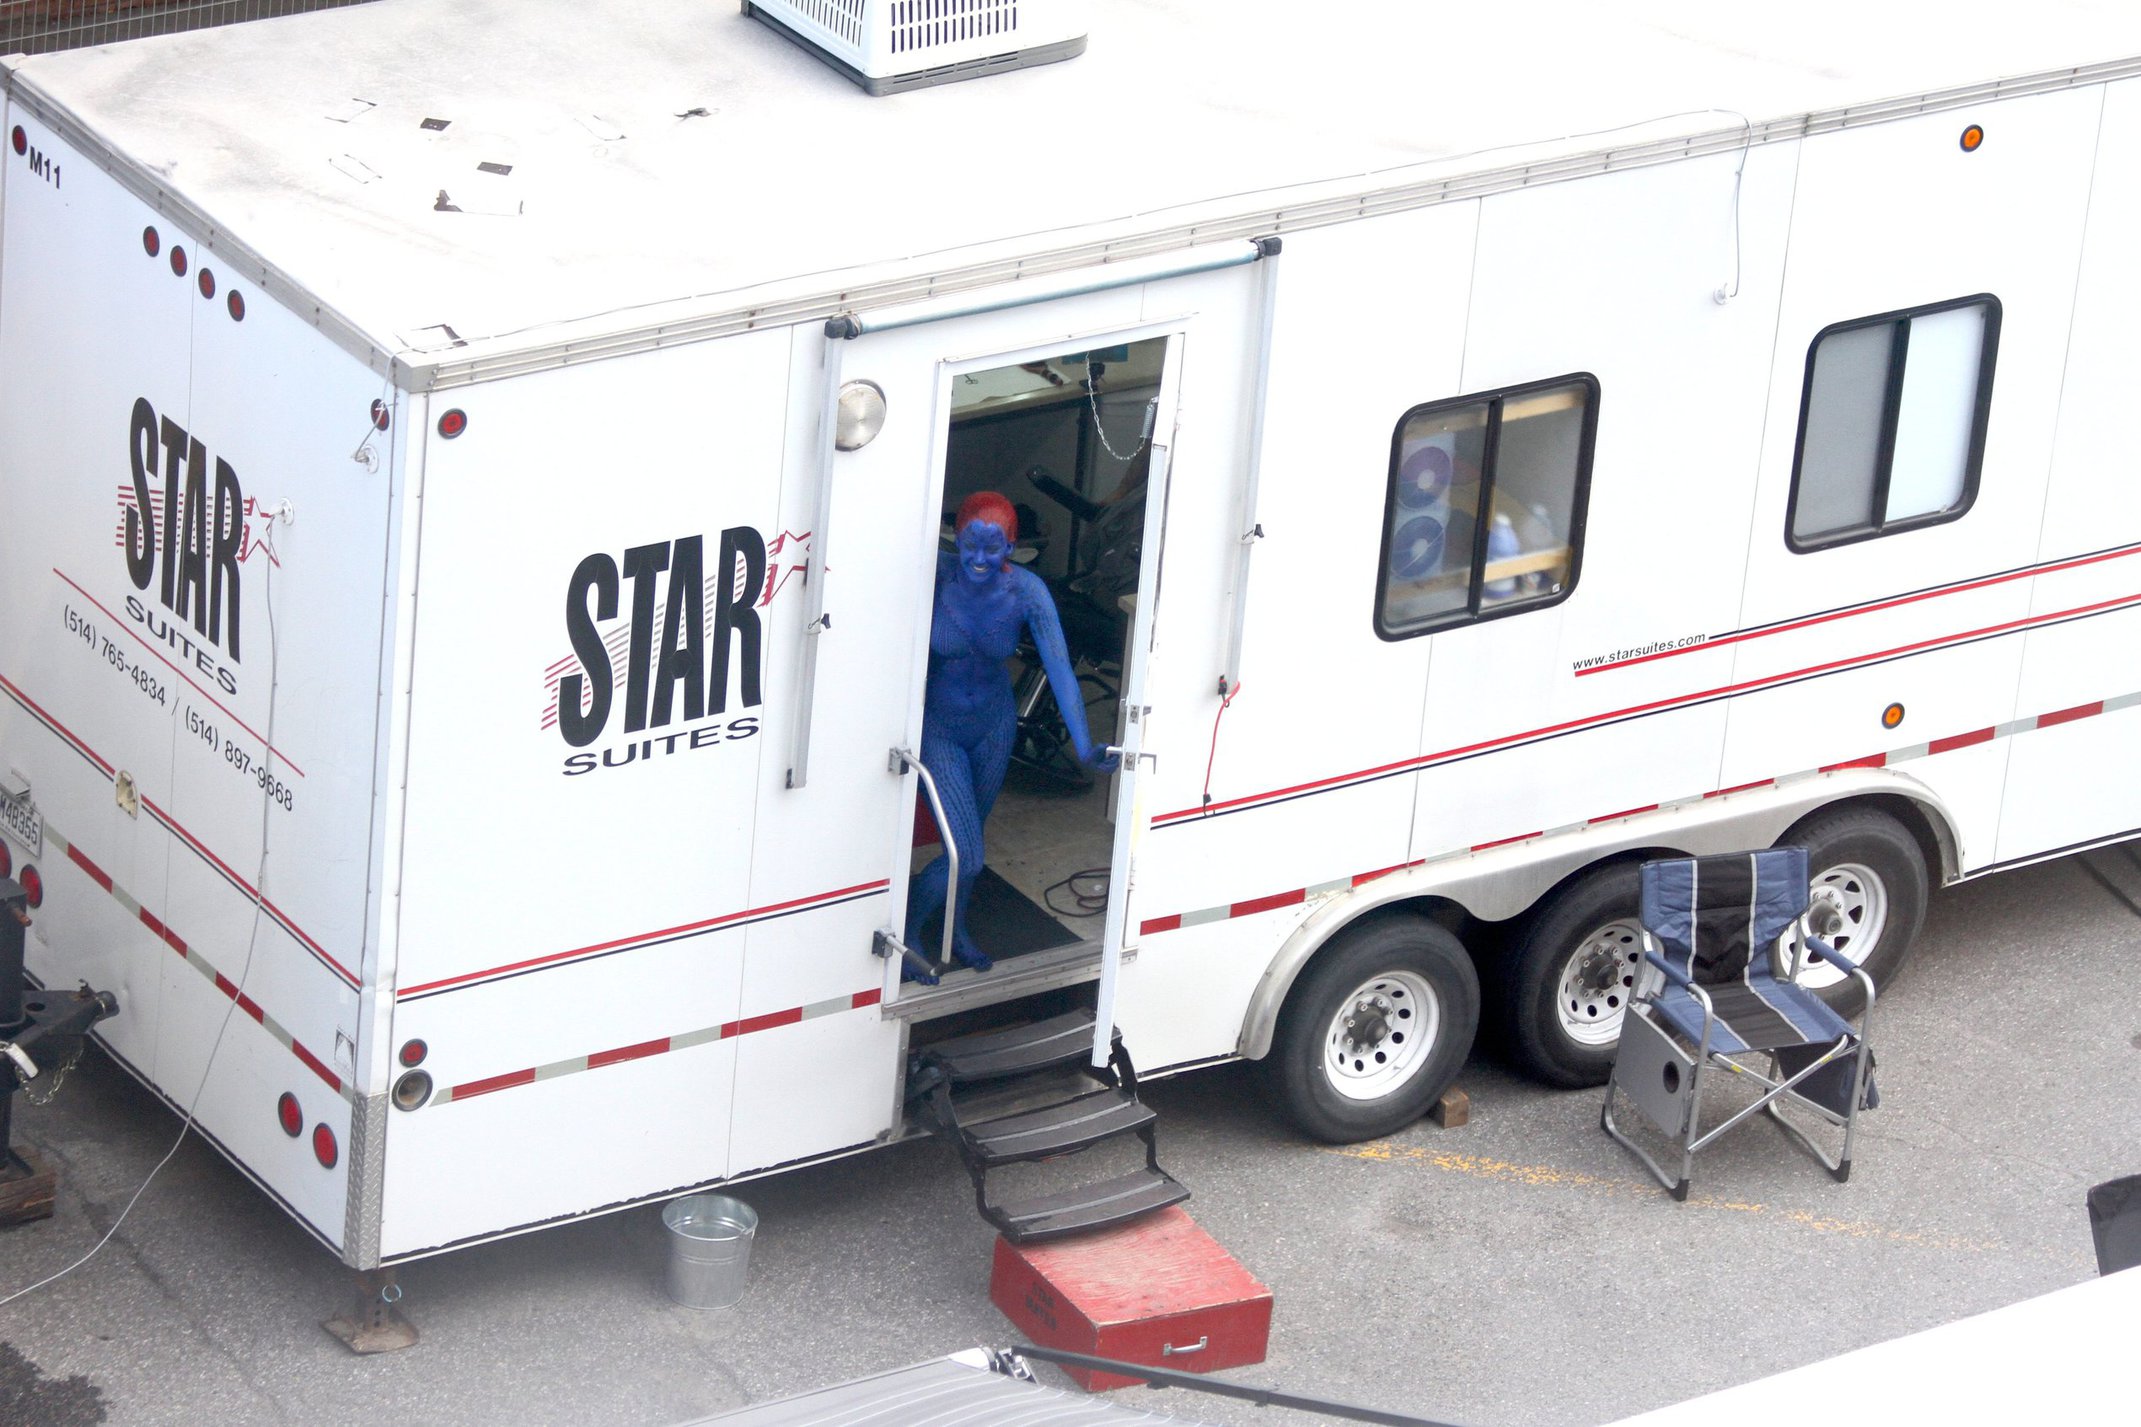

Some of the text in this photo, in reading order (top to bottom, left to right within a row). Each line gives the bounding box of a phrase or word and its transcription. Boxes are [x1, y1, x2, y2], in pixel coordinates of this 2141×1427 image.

[29, 145, 60, 190] M11
[125, 397, 241, 664] STAR
[125, 595, 237, 695] SUITES
[558, 526, 767, 747] STAR
[1572, 633, 1706, 670] www.starsuites.com
[64, 604, 96, 650] (514)
[102, 636, 166, 706] 765-4834
[186, 705, 218, 752] (514)
[225, 740, 293, 812] 897-9668
[562, 717, 760, 776] SUITES
